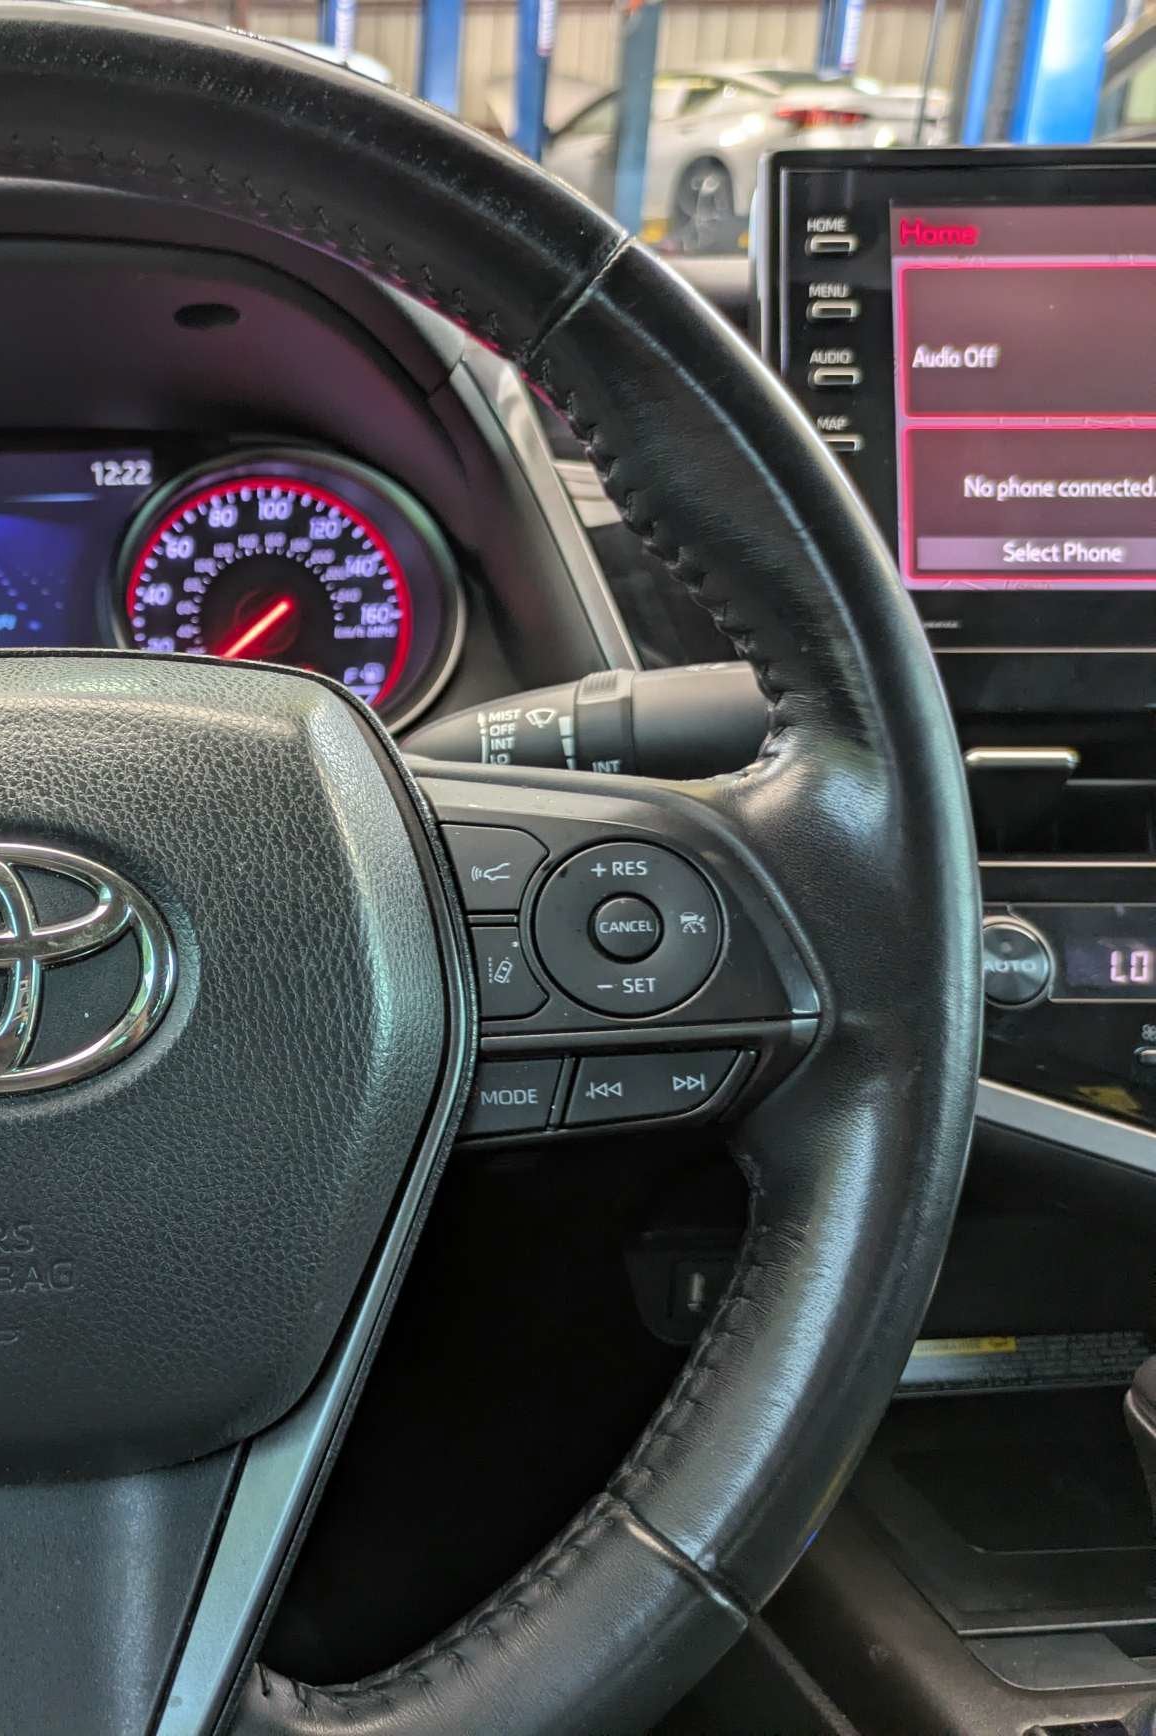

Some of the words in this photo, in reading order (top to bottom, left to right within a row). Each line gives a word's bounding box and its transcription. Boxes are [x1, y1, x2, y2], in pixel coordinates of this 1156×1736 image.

[807, 218, 846, 232] HOME
[900, 219, 979, 246] Home
[809, 284, 849, 298] MENU
[810, 349, 851, 364] AUDIO
[912, 344, 960, 368] Audio
[964, 345, 998, 368] Off
[816, 416, 847, 430] MAP
[964, 475, 993, 497] No
[997, 475, 1055, 501] phone
[208, 504, 238, 528] 80
[258, 499, 293, 520] 100
[309, 516, 342, 540] 120
[165, 535, 194, 559] 60
[1003, 540, 1060, 563] Select
[1063, 541, 1125, 563] Phone
[345, 555, 379, 578] 140
[361, 603, 393, 625] 160
[488, 708, 522, 723] MIST
[489, 722, 516, 737] OFF
[490, 737, 515, 751] INT
[592, 759, 621, 773] INT
[612, 861, 648, 876] RES
[599, 919, 653, 934] CANCEL
[622, 977, 656, 993] SET
[481, 1088, 538, 1106] MODE
